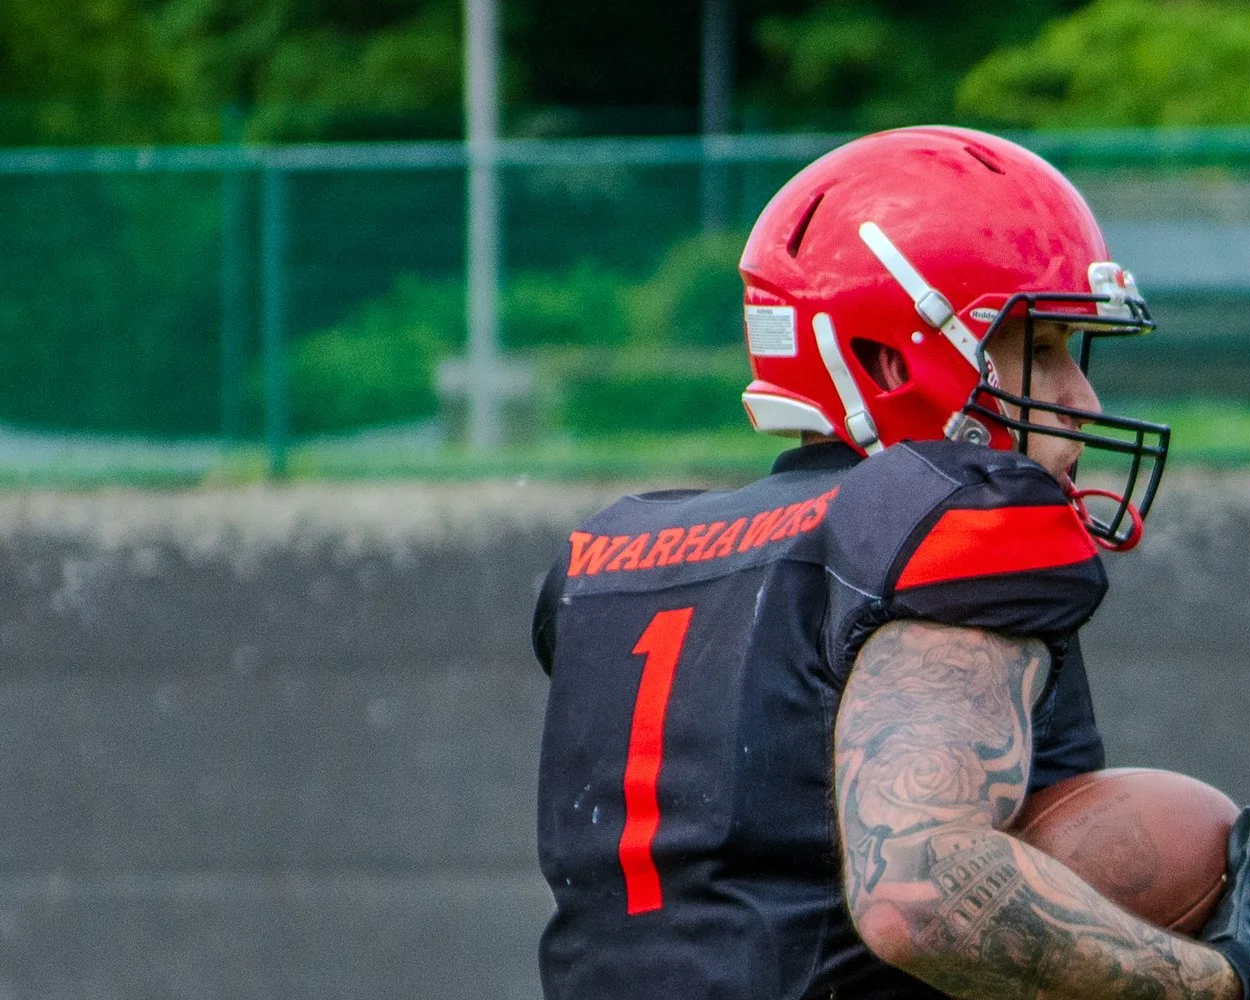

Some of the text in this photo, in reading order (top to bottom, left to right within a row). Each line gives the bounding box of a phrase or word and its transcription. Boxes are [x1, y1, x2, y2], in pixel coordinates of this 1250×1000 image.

[971, 310, 996, 320] Ridde
[567, 486, 840, 577] WARHAWKS
[618, 607, 694, 915] 1
